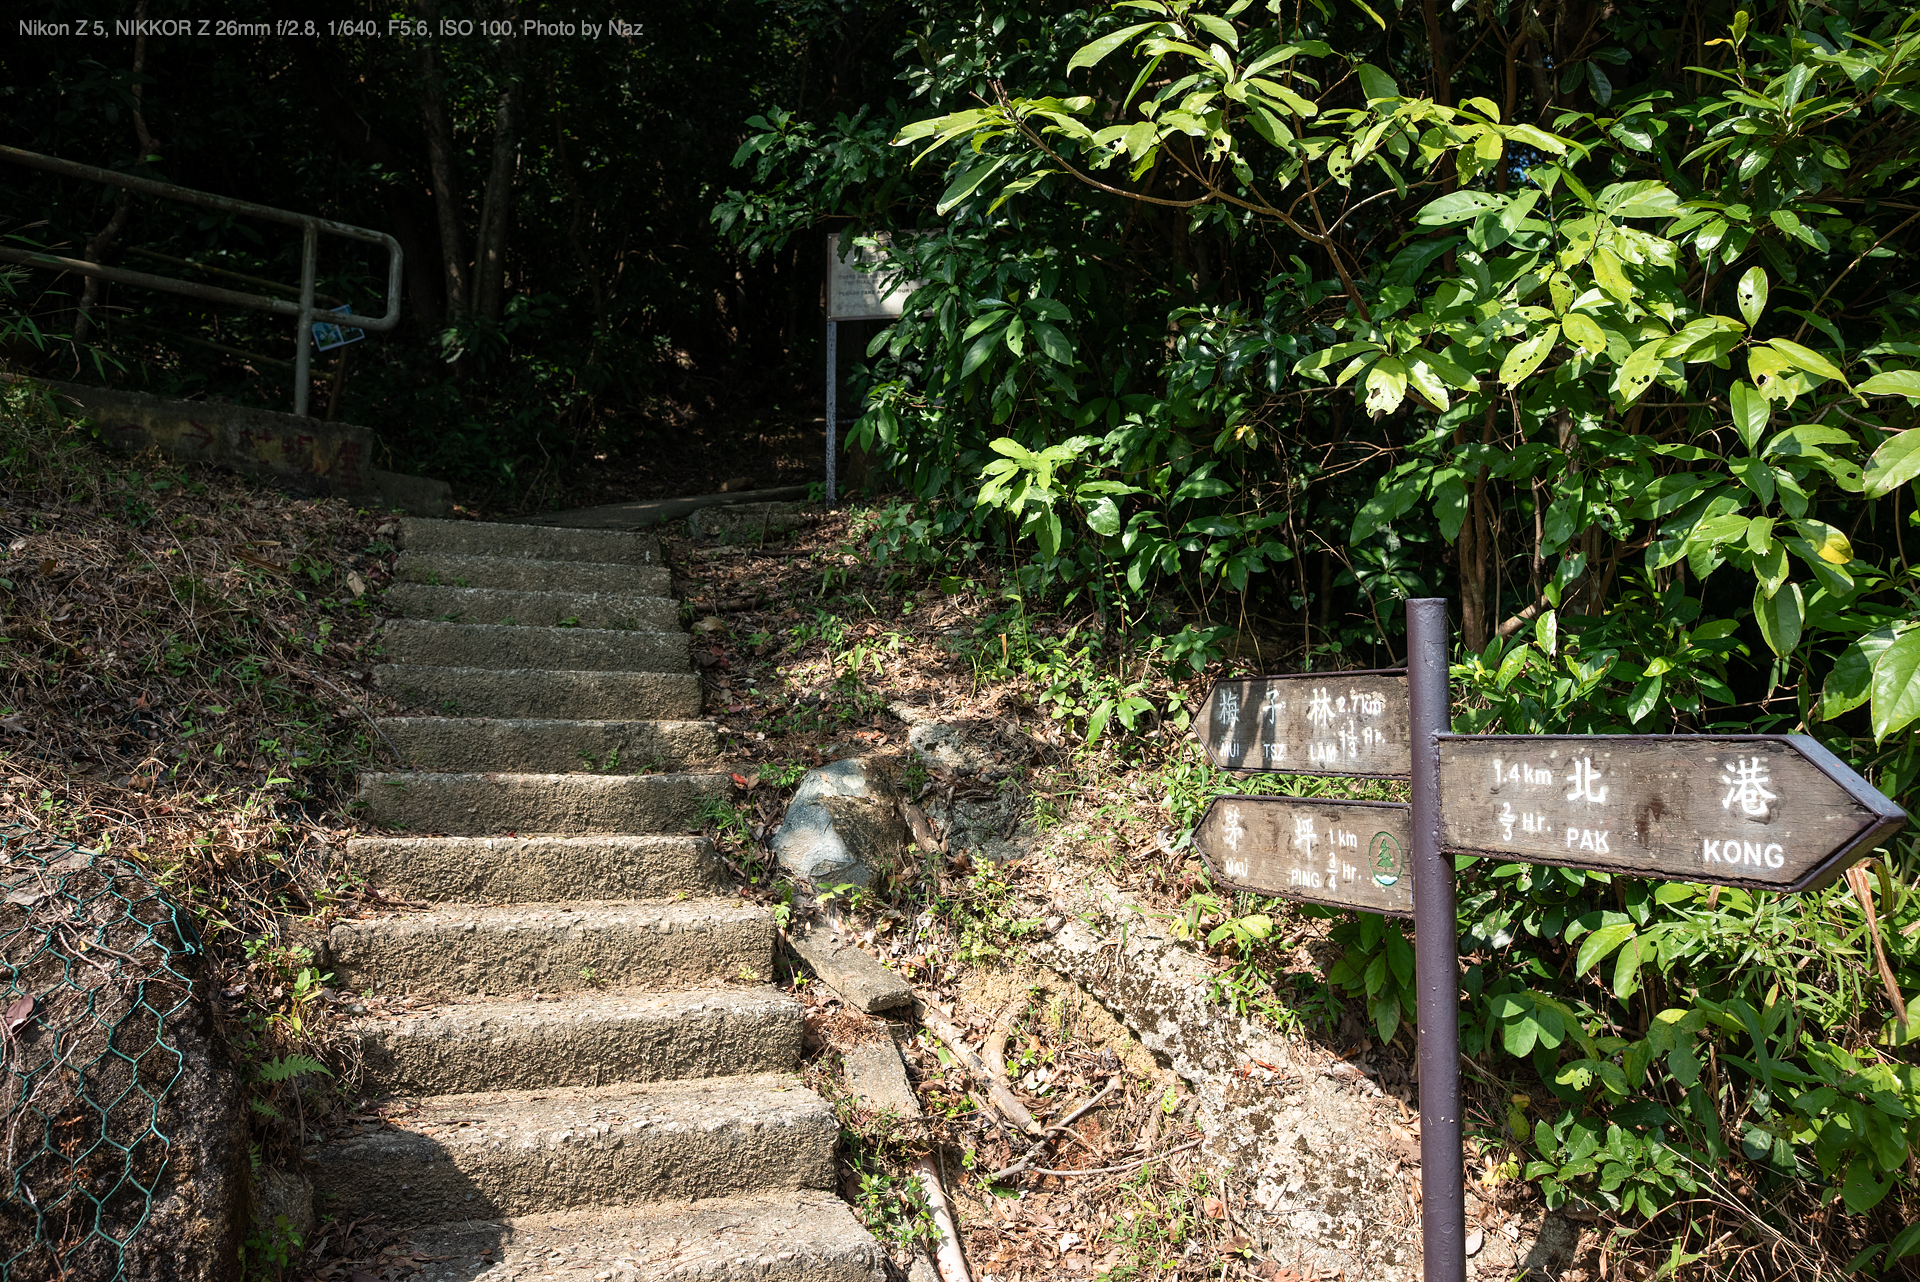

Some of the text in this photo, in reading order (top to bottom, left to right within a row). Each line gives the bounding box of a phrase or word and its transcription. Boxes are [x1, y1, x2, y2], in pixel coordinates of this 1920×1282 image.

[1219, 742, 1337, 762] MUI TSZ LAM
[1521, 812, 1552, 832] Hr.
[1566, 826, 1785, 868] PAK KONG
[1225, 858, 1320, 889] MAU PING
[1342, 862, 1362, 881] Hr.
